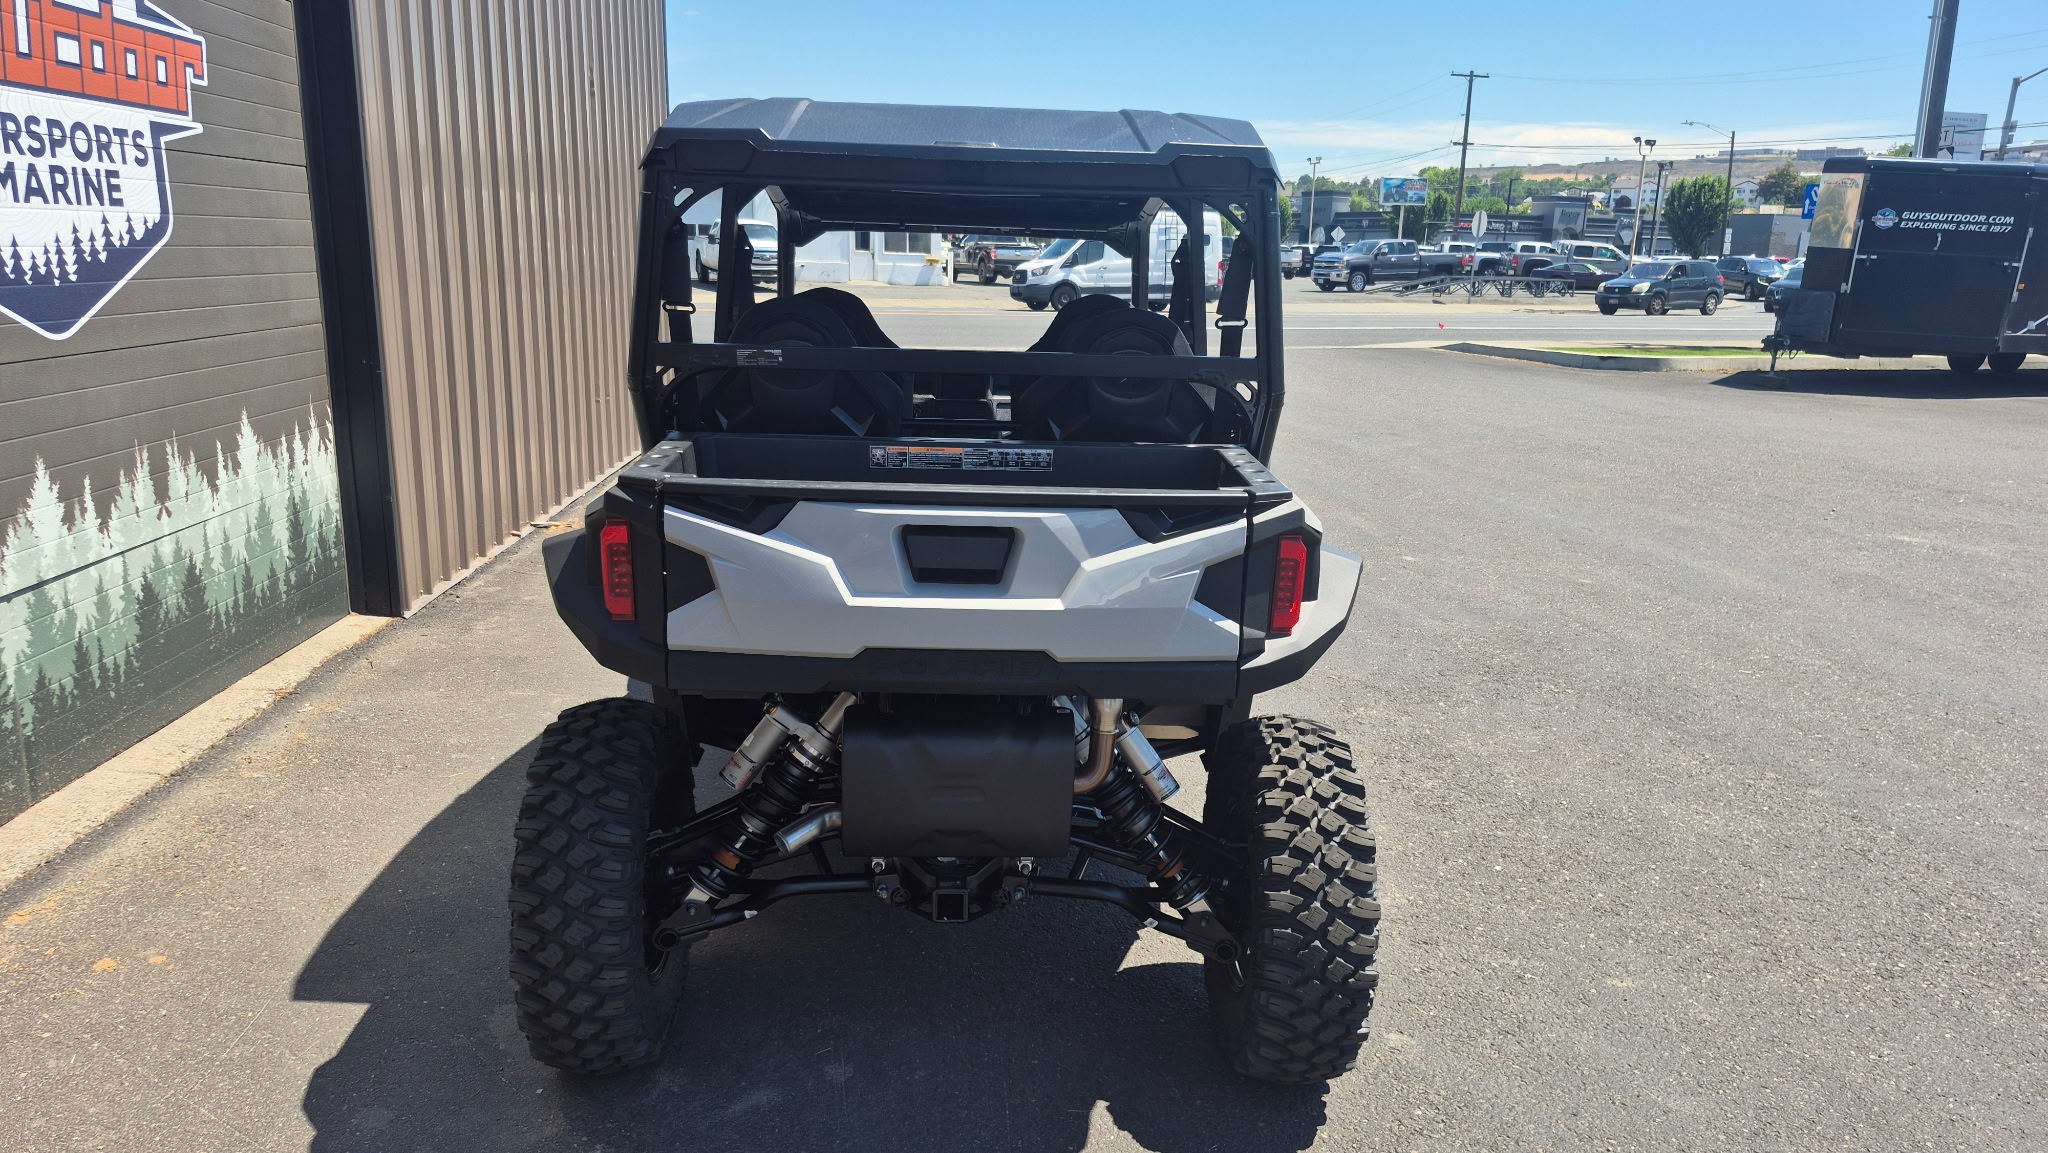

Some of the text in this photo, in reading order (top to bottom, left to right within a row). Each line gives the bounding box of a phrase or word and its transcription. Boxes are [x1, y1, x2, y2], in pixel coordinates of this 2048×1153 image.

[1901, 211, 2015, 224] GUYSOUTDOOR.COM
[1899, 221, 2012, 233] EXPLORING SINCE 1977
